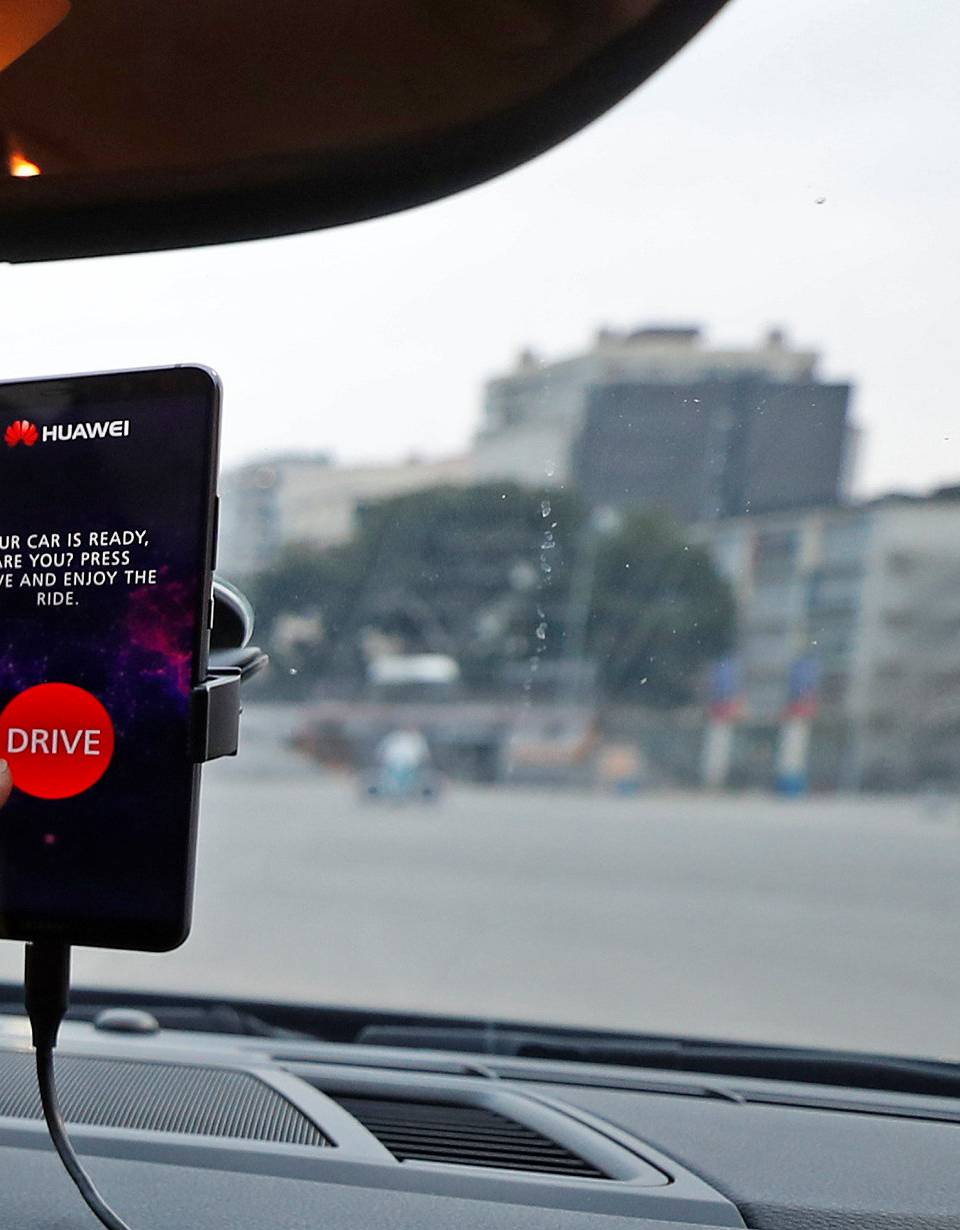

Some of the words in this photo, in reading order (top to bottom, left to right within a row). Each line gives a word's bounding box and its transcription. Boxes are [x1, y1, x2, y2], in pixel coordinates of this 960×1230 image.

[42, 420, 129, 442] HUAWEI
[27, 534, 60, 548] CAR
[68, 533, 81, 547] IS
[90, 530, 148, 546] READY,
[29, 553, 73, 567] YOU?
[81, 551, 129, 565] PRESS
[20, 573, 56, 586] AND
[64, 571, 117, 586] ENJOY
[125, 570, 156, 584] THE
[38, 592, 78, 605] RIDE.
[7, 728, 101, 755] DRIVE
